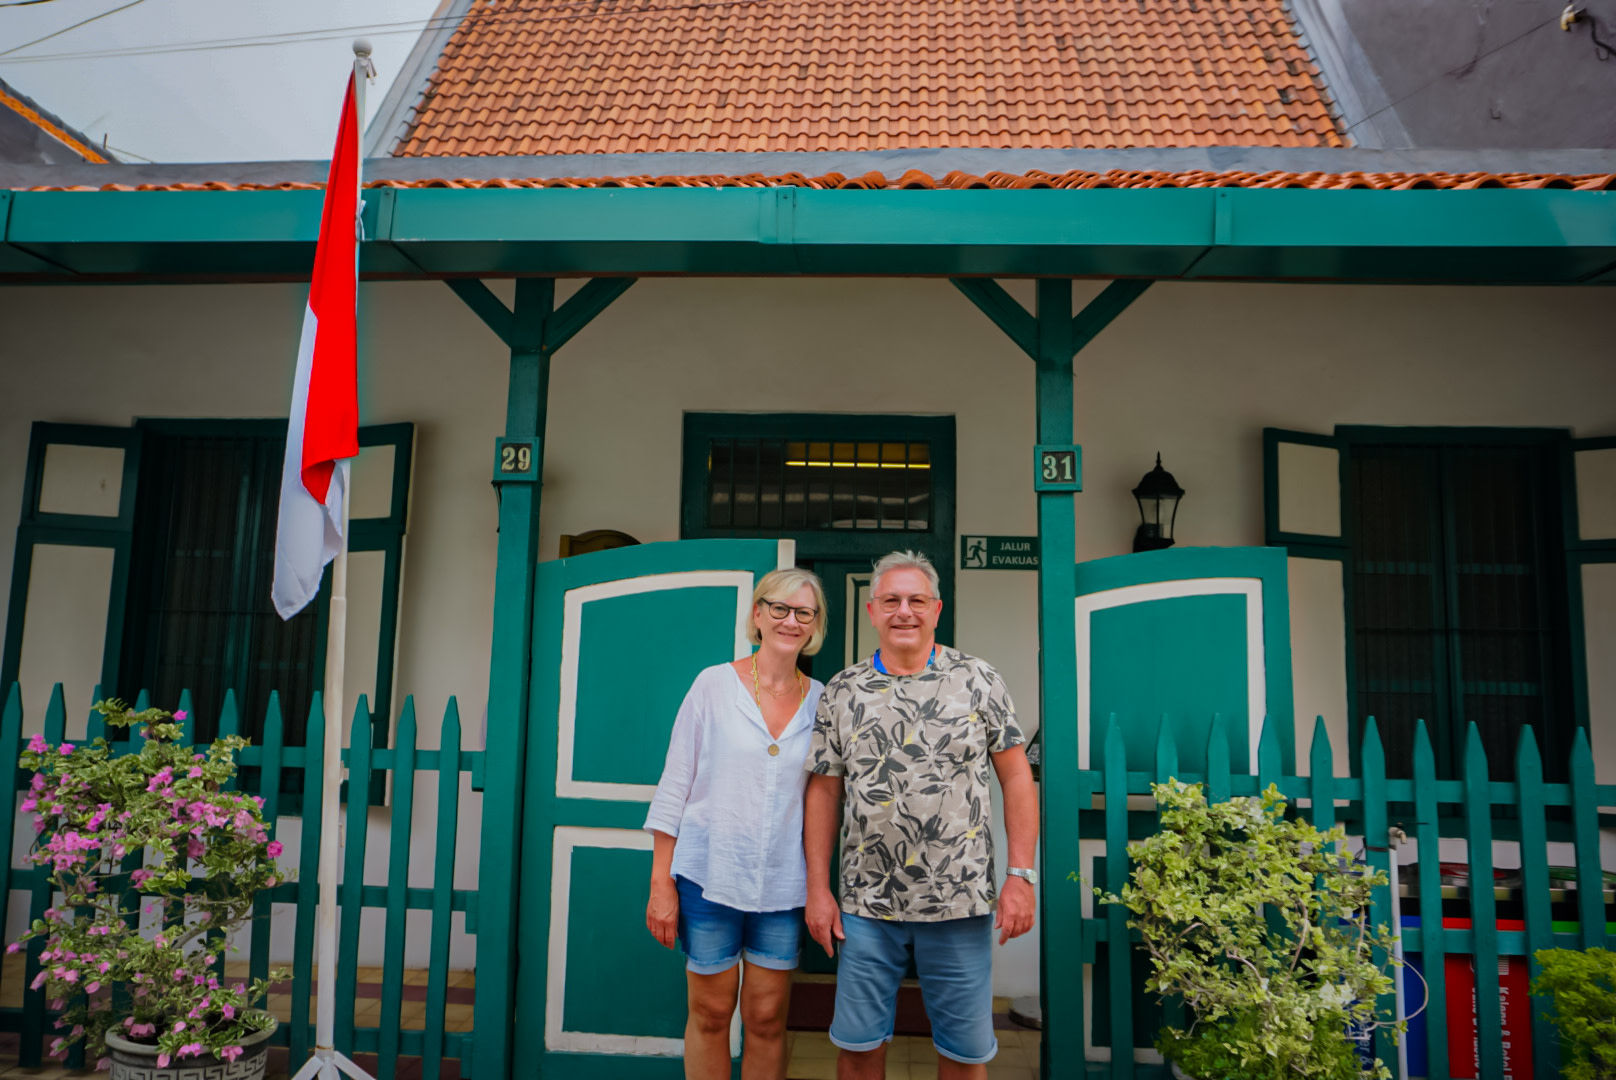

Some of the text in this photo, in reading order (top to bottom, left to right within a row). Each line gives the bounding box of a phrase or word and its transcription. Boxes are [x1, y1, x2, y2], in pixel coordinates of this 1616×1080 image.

[501, 446, 531, 471] 29
[1043, 455, 1073, 480] 31
[1000, 542, 1031, 552] JALUR
[992, 556, 1039, 565] EVAKUAS
